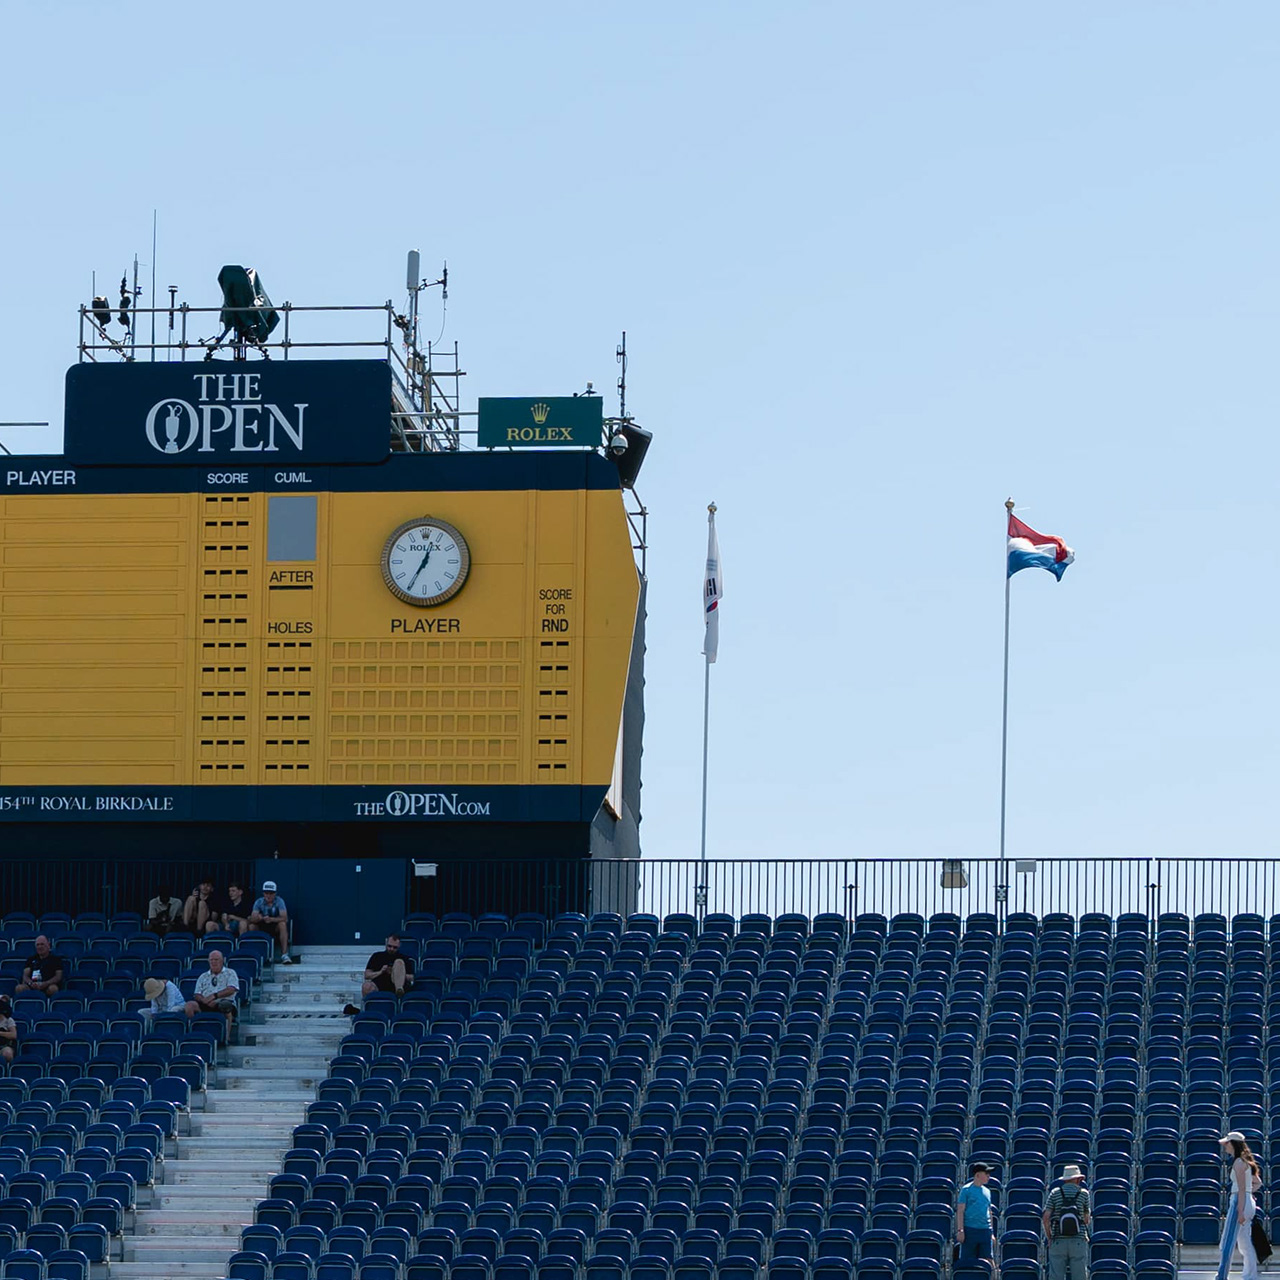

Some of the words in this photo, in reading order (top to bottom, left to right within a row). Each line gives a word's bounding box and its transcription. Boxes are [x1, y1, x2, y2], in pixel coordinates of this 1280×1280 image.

[193, 374, 262, 401] THE
[145, 398, 309, 454] OPEN
[507, 427, 574, 441] ROLEX
[6, 470, 76, 486] PLAYER
[207, 473, 249, 484] SCORE
[274, 472, 312, 483] CUML.
[269, 570, 314, 582] AFTER
[539, 589, 573, 600] SCORE
[545, 604, 566, 615] FOR
[268, 622, 313, 634] HOLES
[390, 619, 461, 633] PLAYER
[541, 619, 569, 633] RND
[0, 796, 35, 810] 154TH
[40, 796, 91, 810] ROYAL
[95, 797, 174, 810] BIRKDALE
